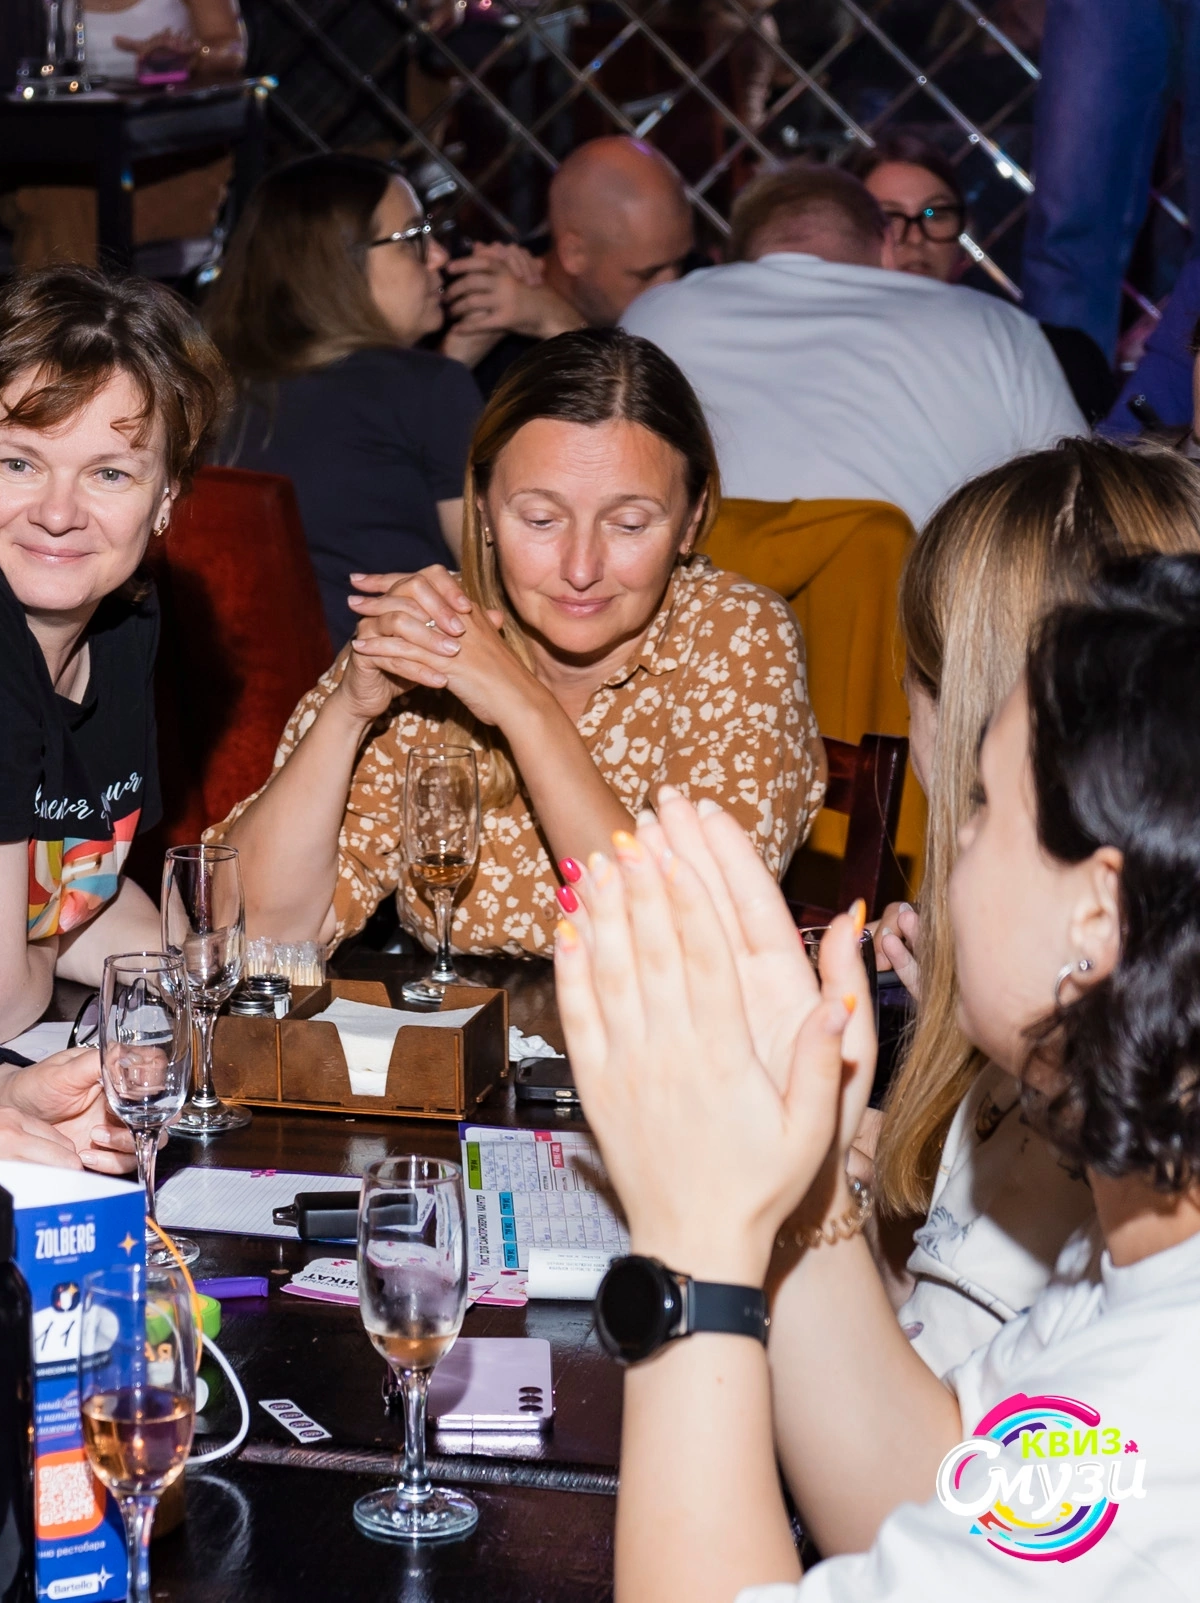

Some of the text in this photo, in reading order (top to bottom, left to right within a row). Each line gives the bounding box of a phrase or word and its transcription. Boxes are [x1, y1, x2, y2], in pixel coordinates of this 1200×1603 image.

[35, 1222, 96, 1260] ZOLBERG
[303, 1273, 358, 1286] ИКАТ
[56, 1540, 106, 1558] рестобара
